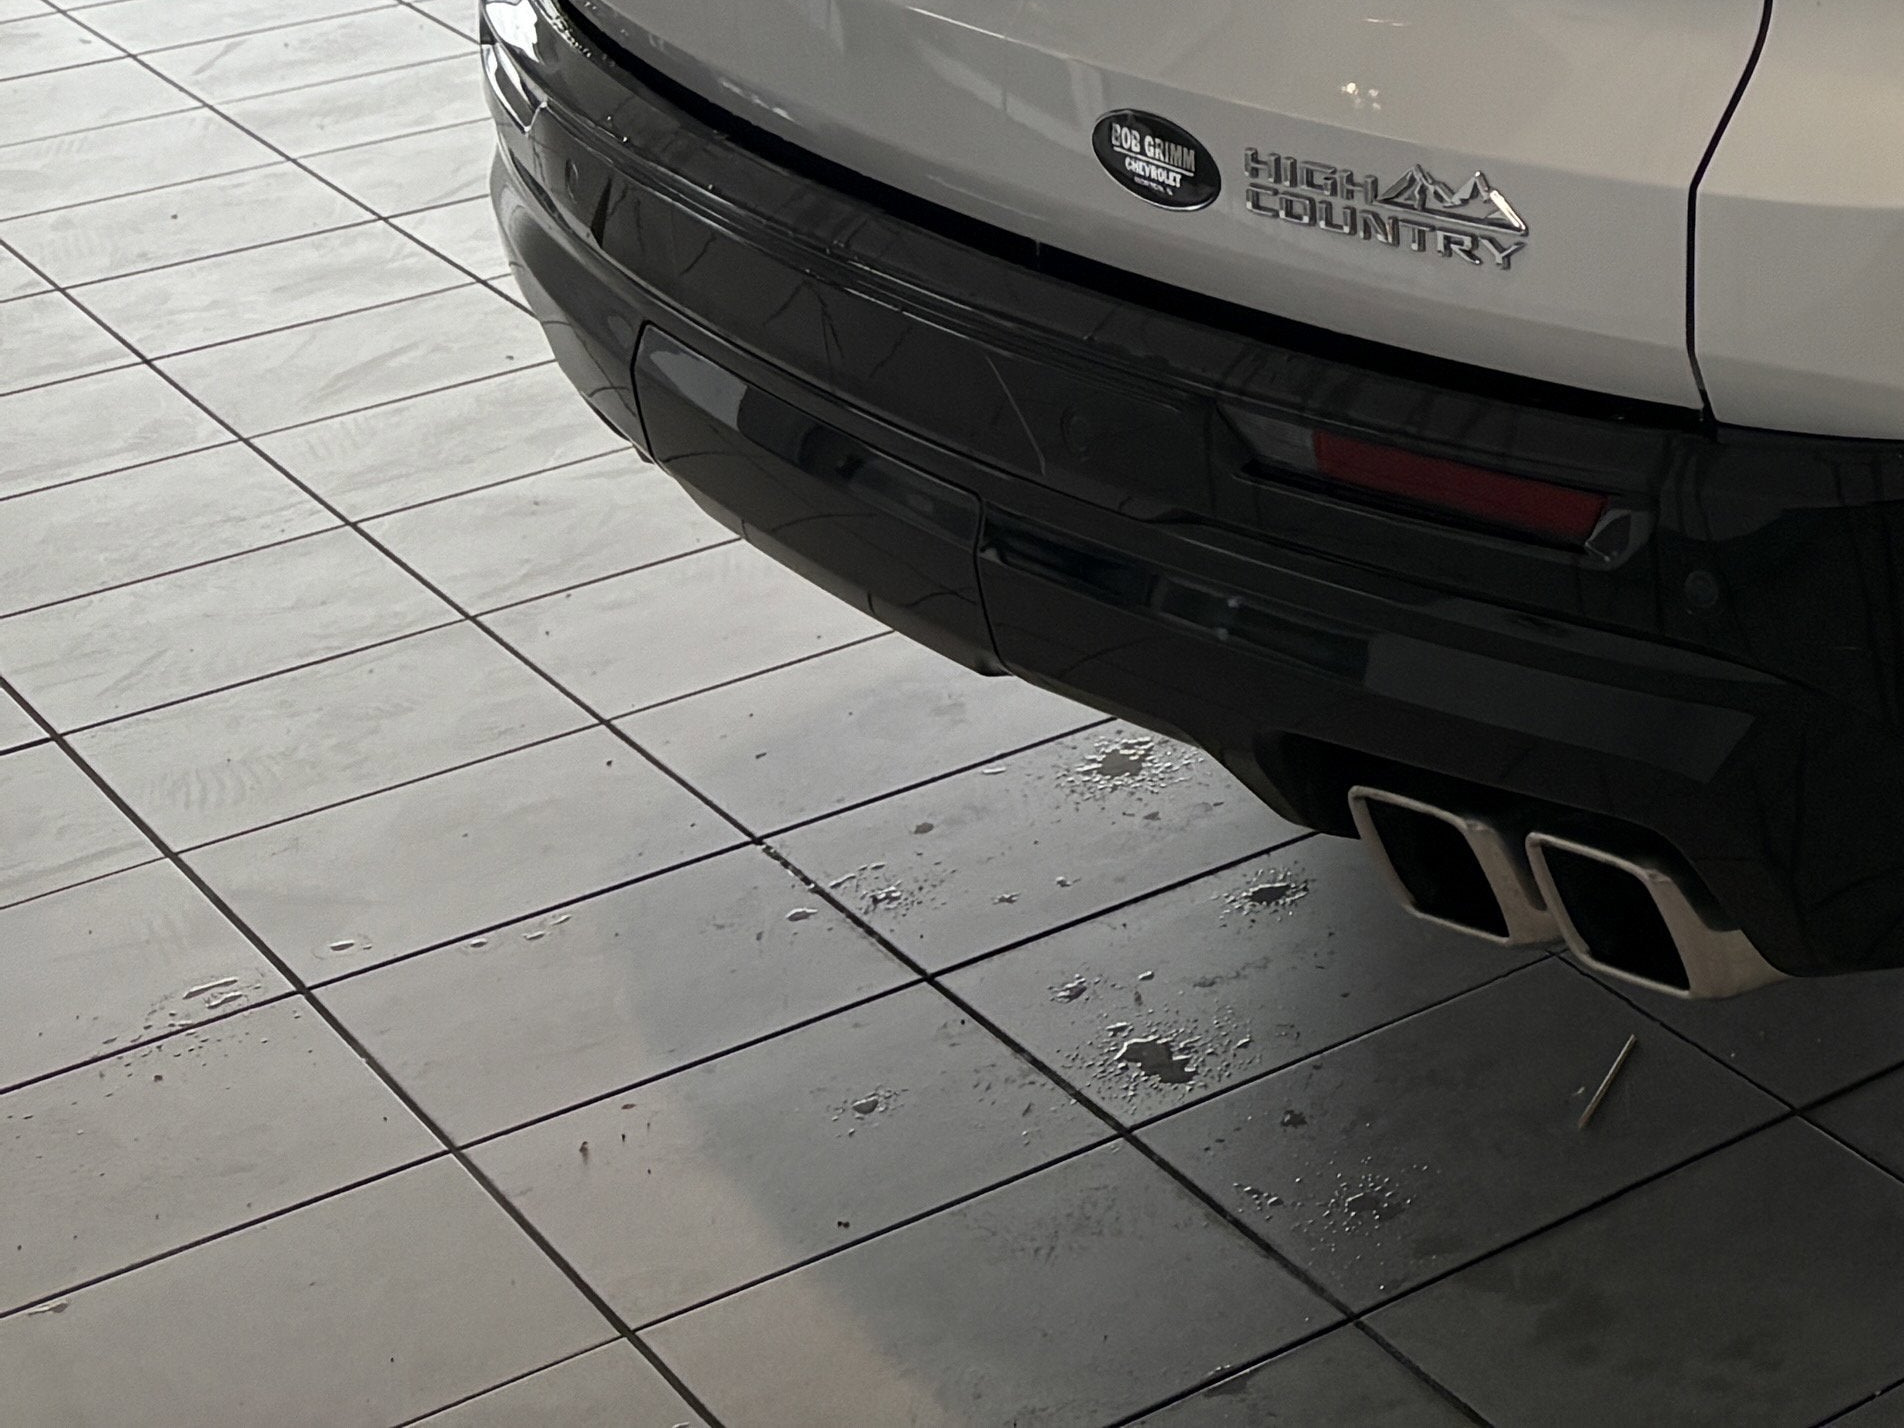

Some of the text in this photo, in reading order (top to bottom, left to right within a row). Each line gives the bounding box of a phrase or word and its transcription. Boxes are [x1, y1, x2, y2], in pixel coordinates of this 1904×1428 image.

[1111, 122, 1196, 173] BOB GRIMM
[1125, 156, 1182, 189] CHEVROLET
[1244, 146, 1379, 206] HIGH
[1245, 182, 1528, 271] COUNTRY
